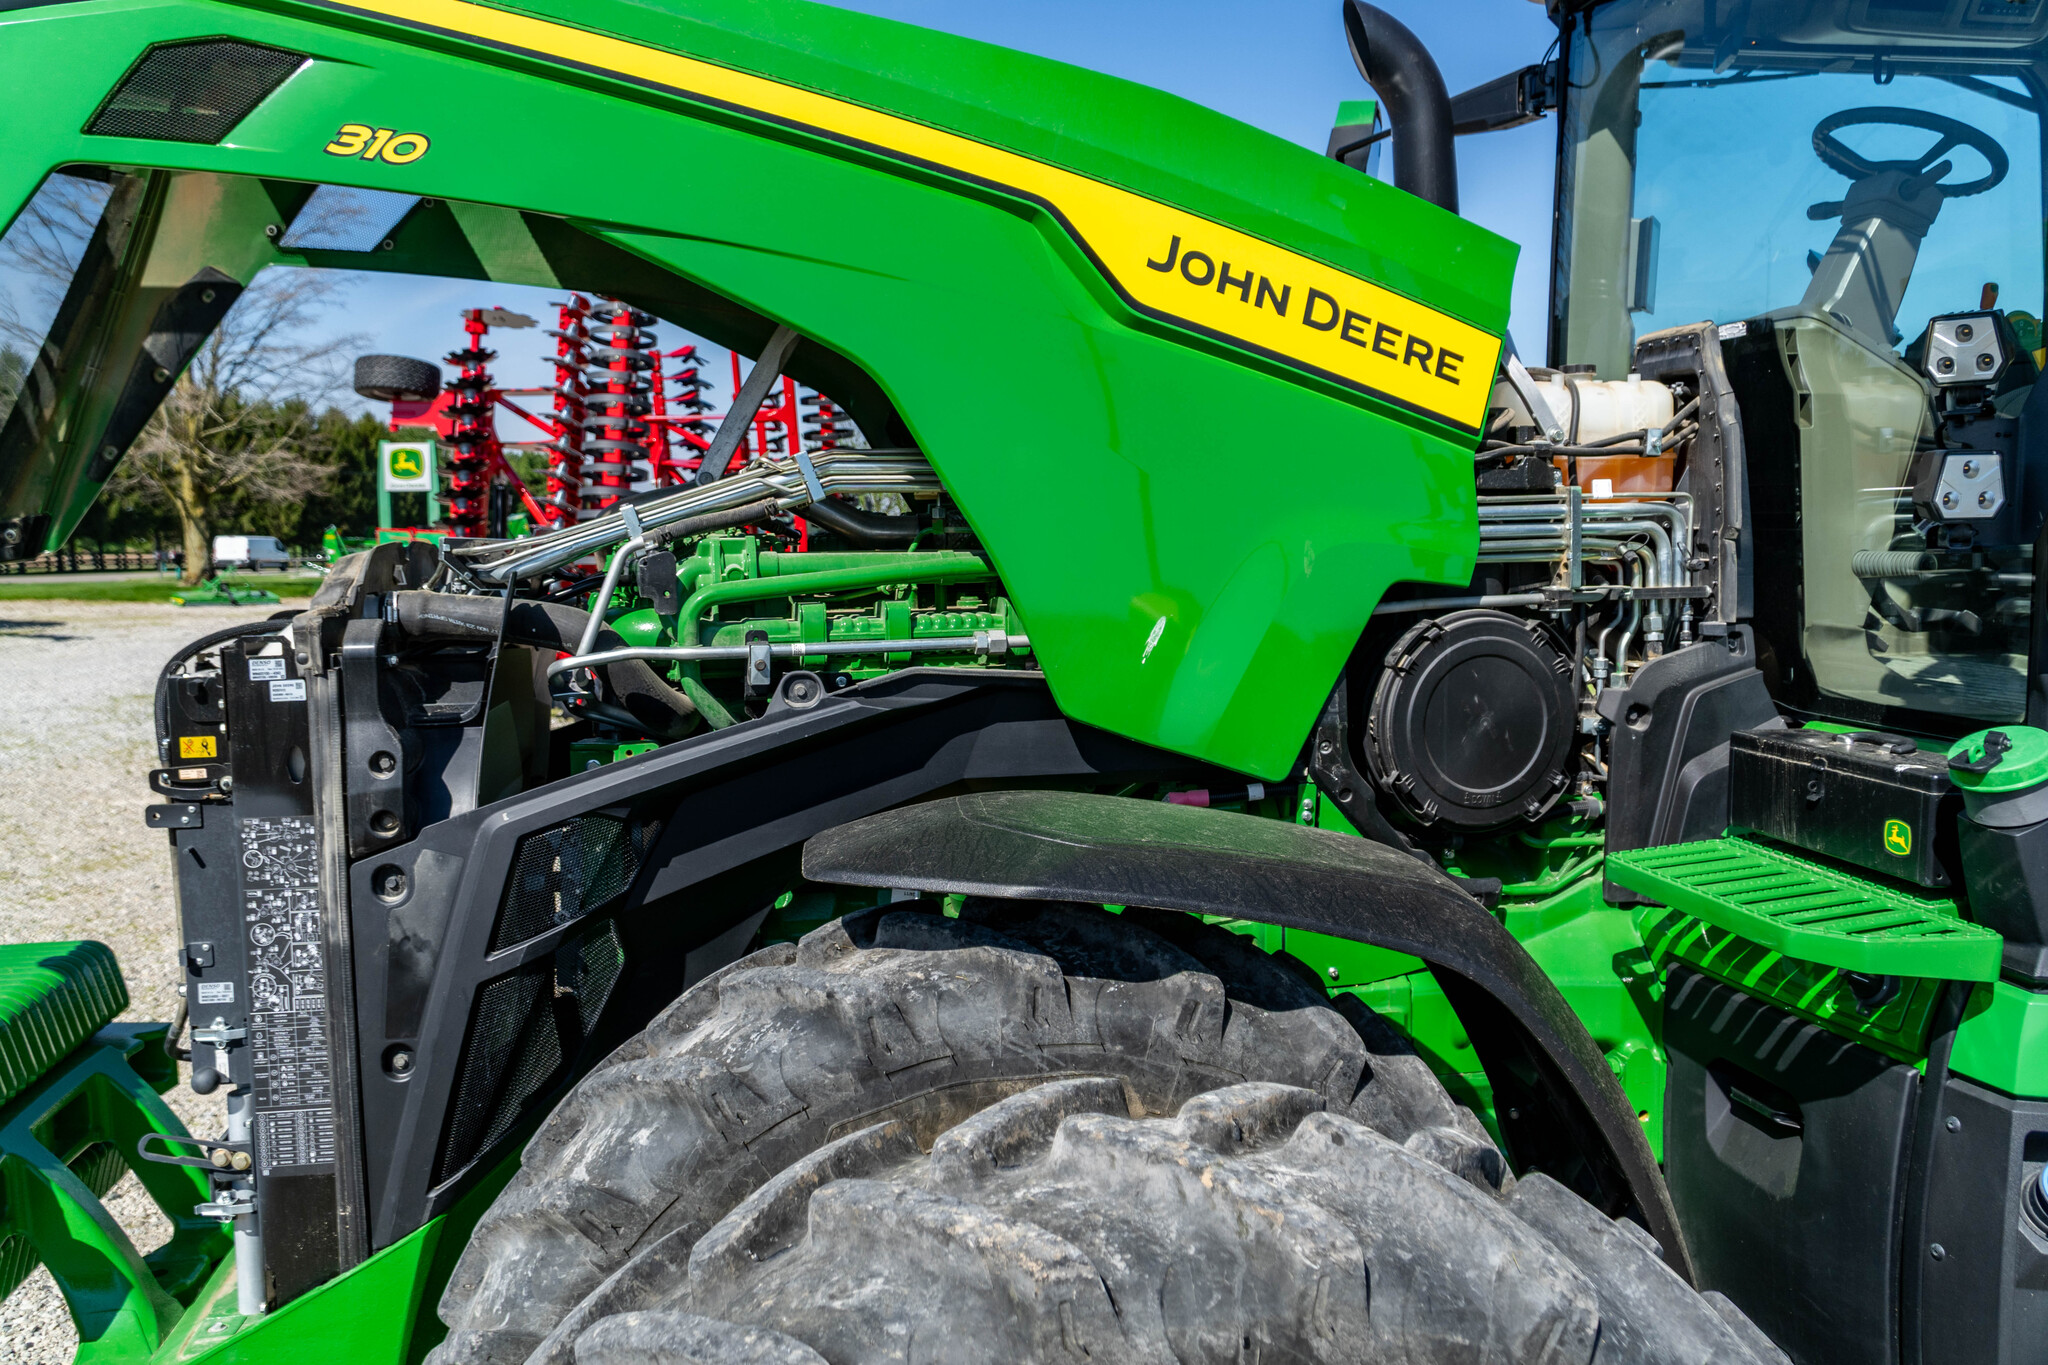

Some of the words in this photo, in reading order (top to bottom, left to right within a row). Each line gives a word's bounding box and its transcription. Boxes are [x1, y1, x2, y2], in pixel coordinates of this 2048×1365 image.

[323, 123, 431, 165] 310
[1146, 234, 1293, 318] JOHN
[1302, 286, 1465, 385] DEERE
